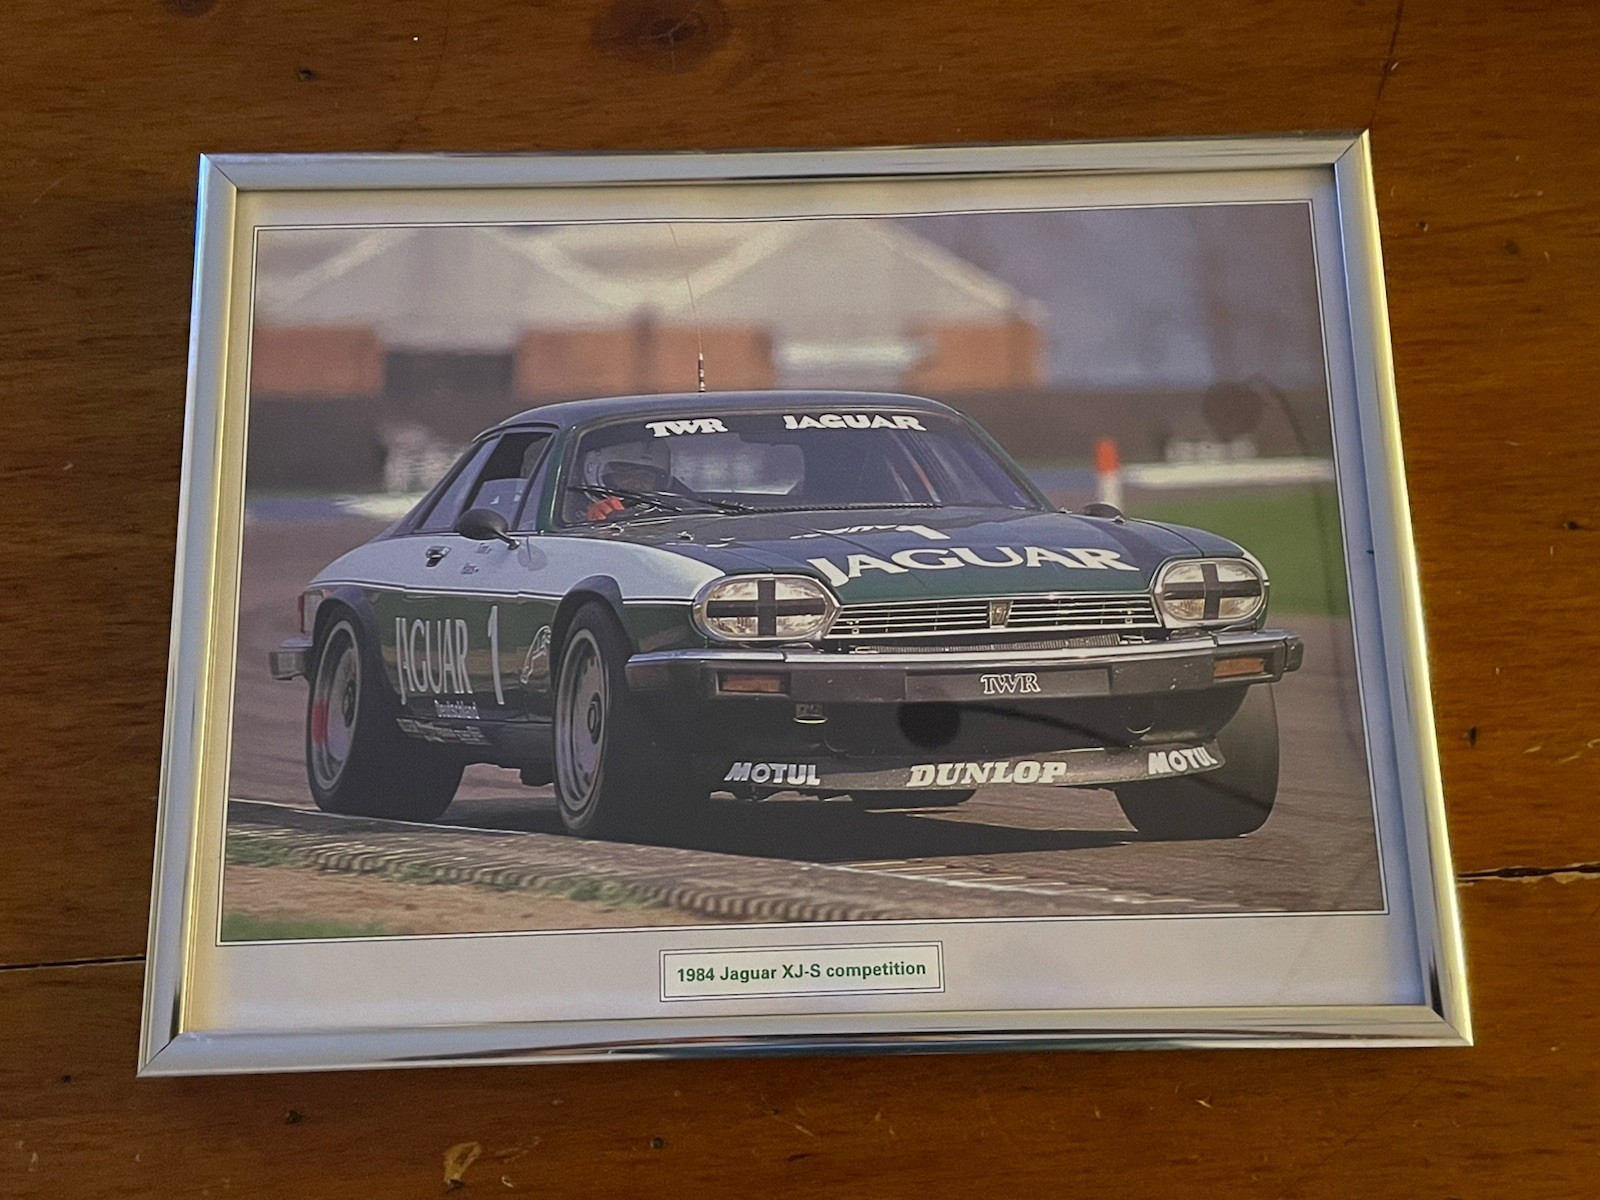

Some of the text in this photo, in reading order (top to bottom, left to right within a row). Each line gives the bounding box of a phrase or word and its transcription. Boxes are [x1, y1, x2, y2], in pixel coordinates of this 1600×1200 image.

[645, 414, 926, 437] TWR JAGUAR
[807, 547, 1140, 587] JAGUAR
[396, 605, 505, 705] JAGUAR 1
[981, 673, 1041, 693] TWR
[1147, 746, 1219, 774] MOTUL
[725, 762, 820, 786] MOTUL
[906, 761, 1068, 787] DUNLOP
[677, 962, 926, 983] 1984 Jaguar XJ-S competition
